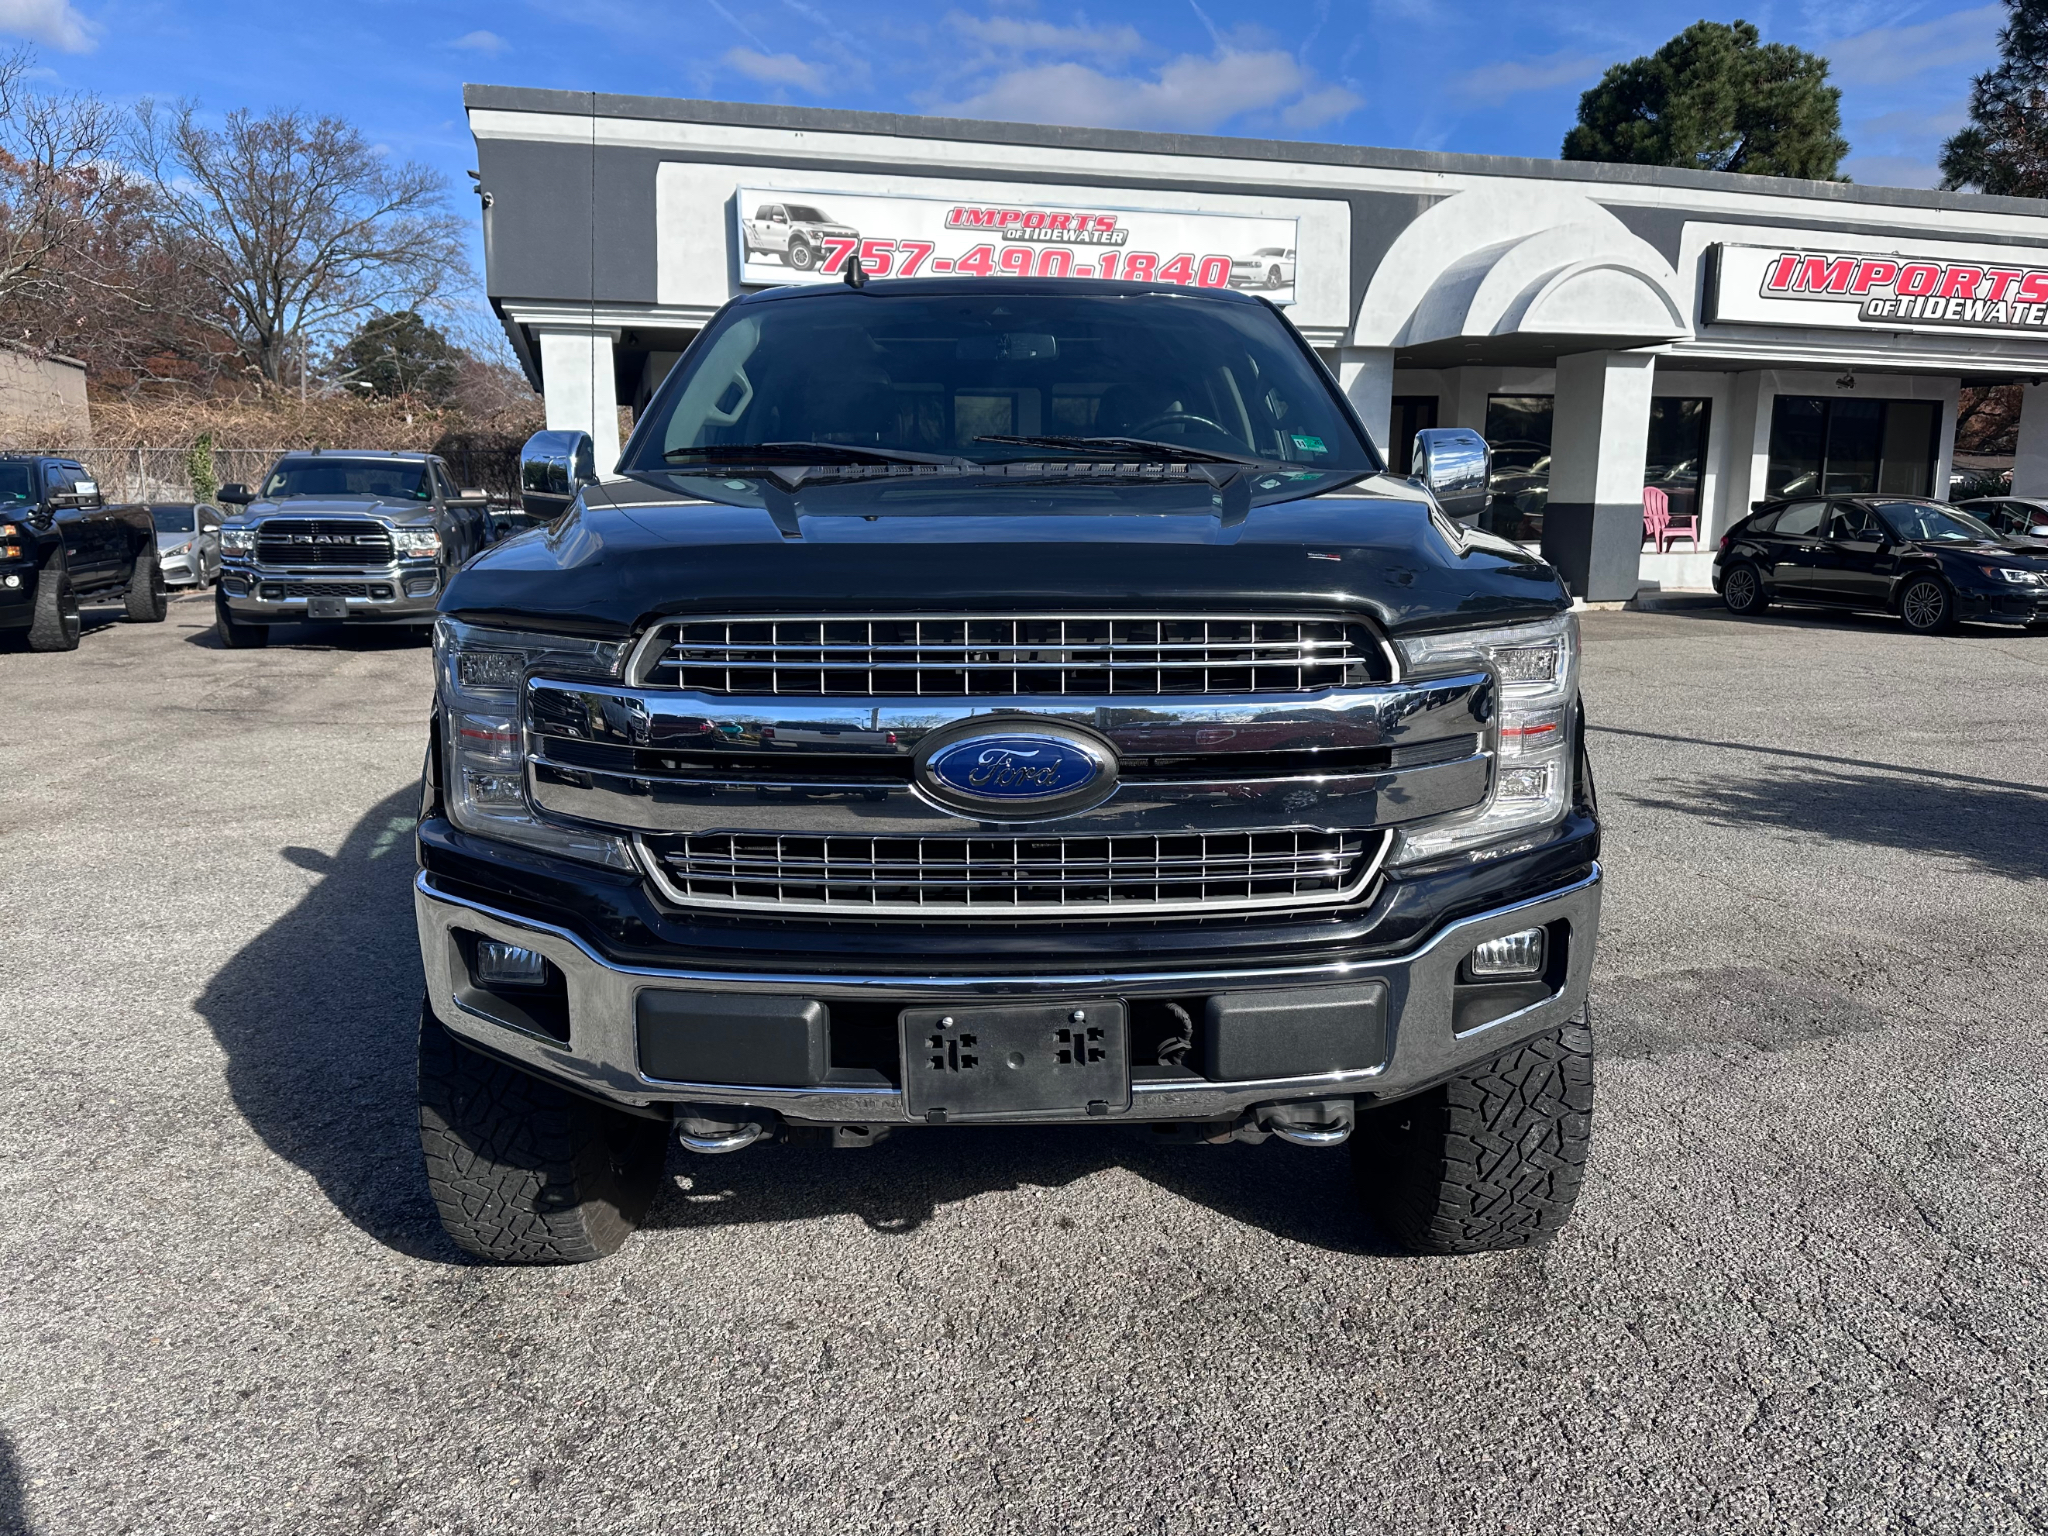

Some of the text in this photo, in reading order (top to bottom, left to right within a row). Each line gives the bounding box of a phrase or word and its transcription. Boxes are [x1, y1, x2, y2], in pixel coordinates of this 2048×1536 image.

[949, 207, 1118, 232] IMPORTS
[819, 236, 1233, 289] 757-490-1840
[1767, 253, 2048, 303] IMPORTS
[1895, 295, 2048, 326] TIDEWATE
[294, 534, 352, 544] RAM
[968, 748, 1063, 787] Ford
